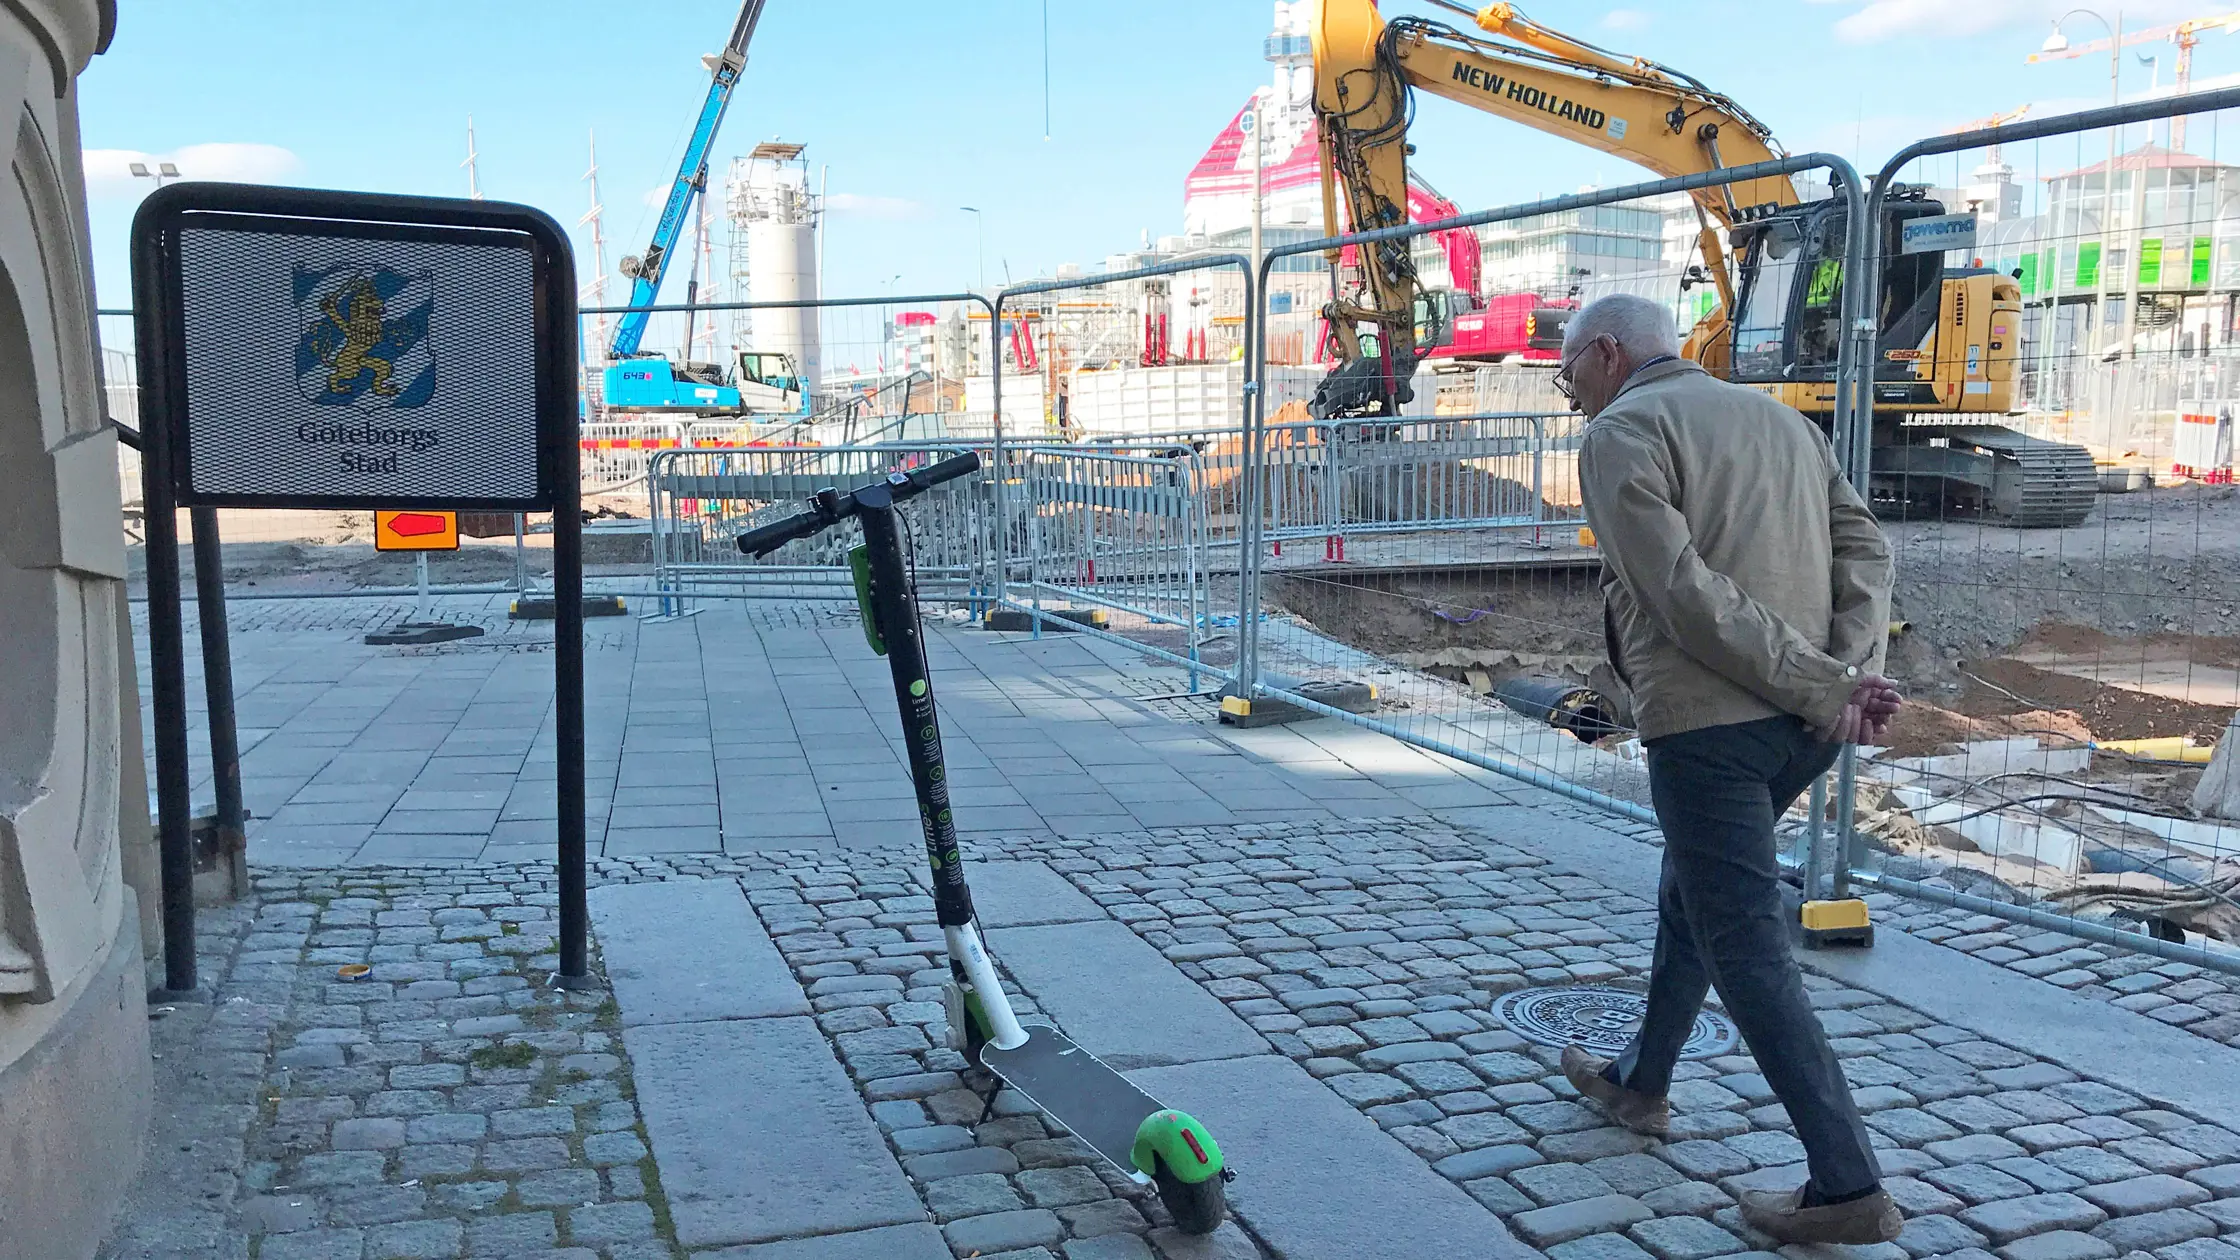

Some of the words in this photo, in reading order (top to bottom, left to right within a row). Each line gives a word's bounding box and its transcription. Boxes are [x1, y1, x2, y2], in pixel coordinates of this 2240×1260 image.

[1452, 61, 1505, 95] NEW
[1506, 81, 1605, 129] HOLLAND
[623, 372, 645, 380] 643
[298, 422, 438, 451] Göteborgs
[341, 452, 397, 473] Stad
